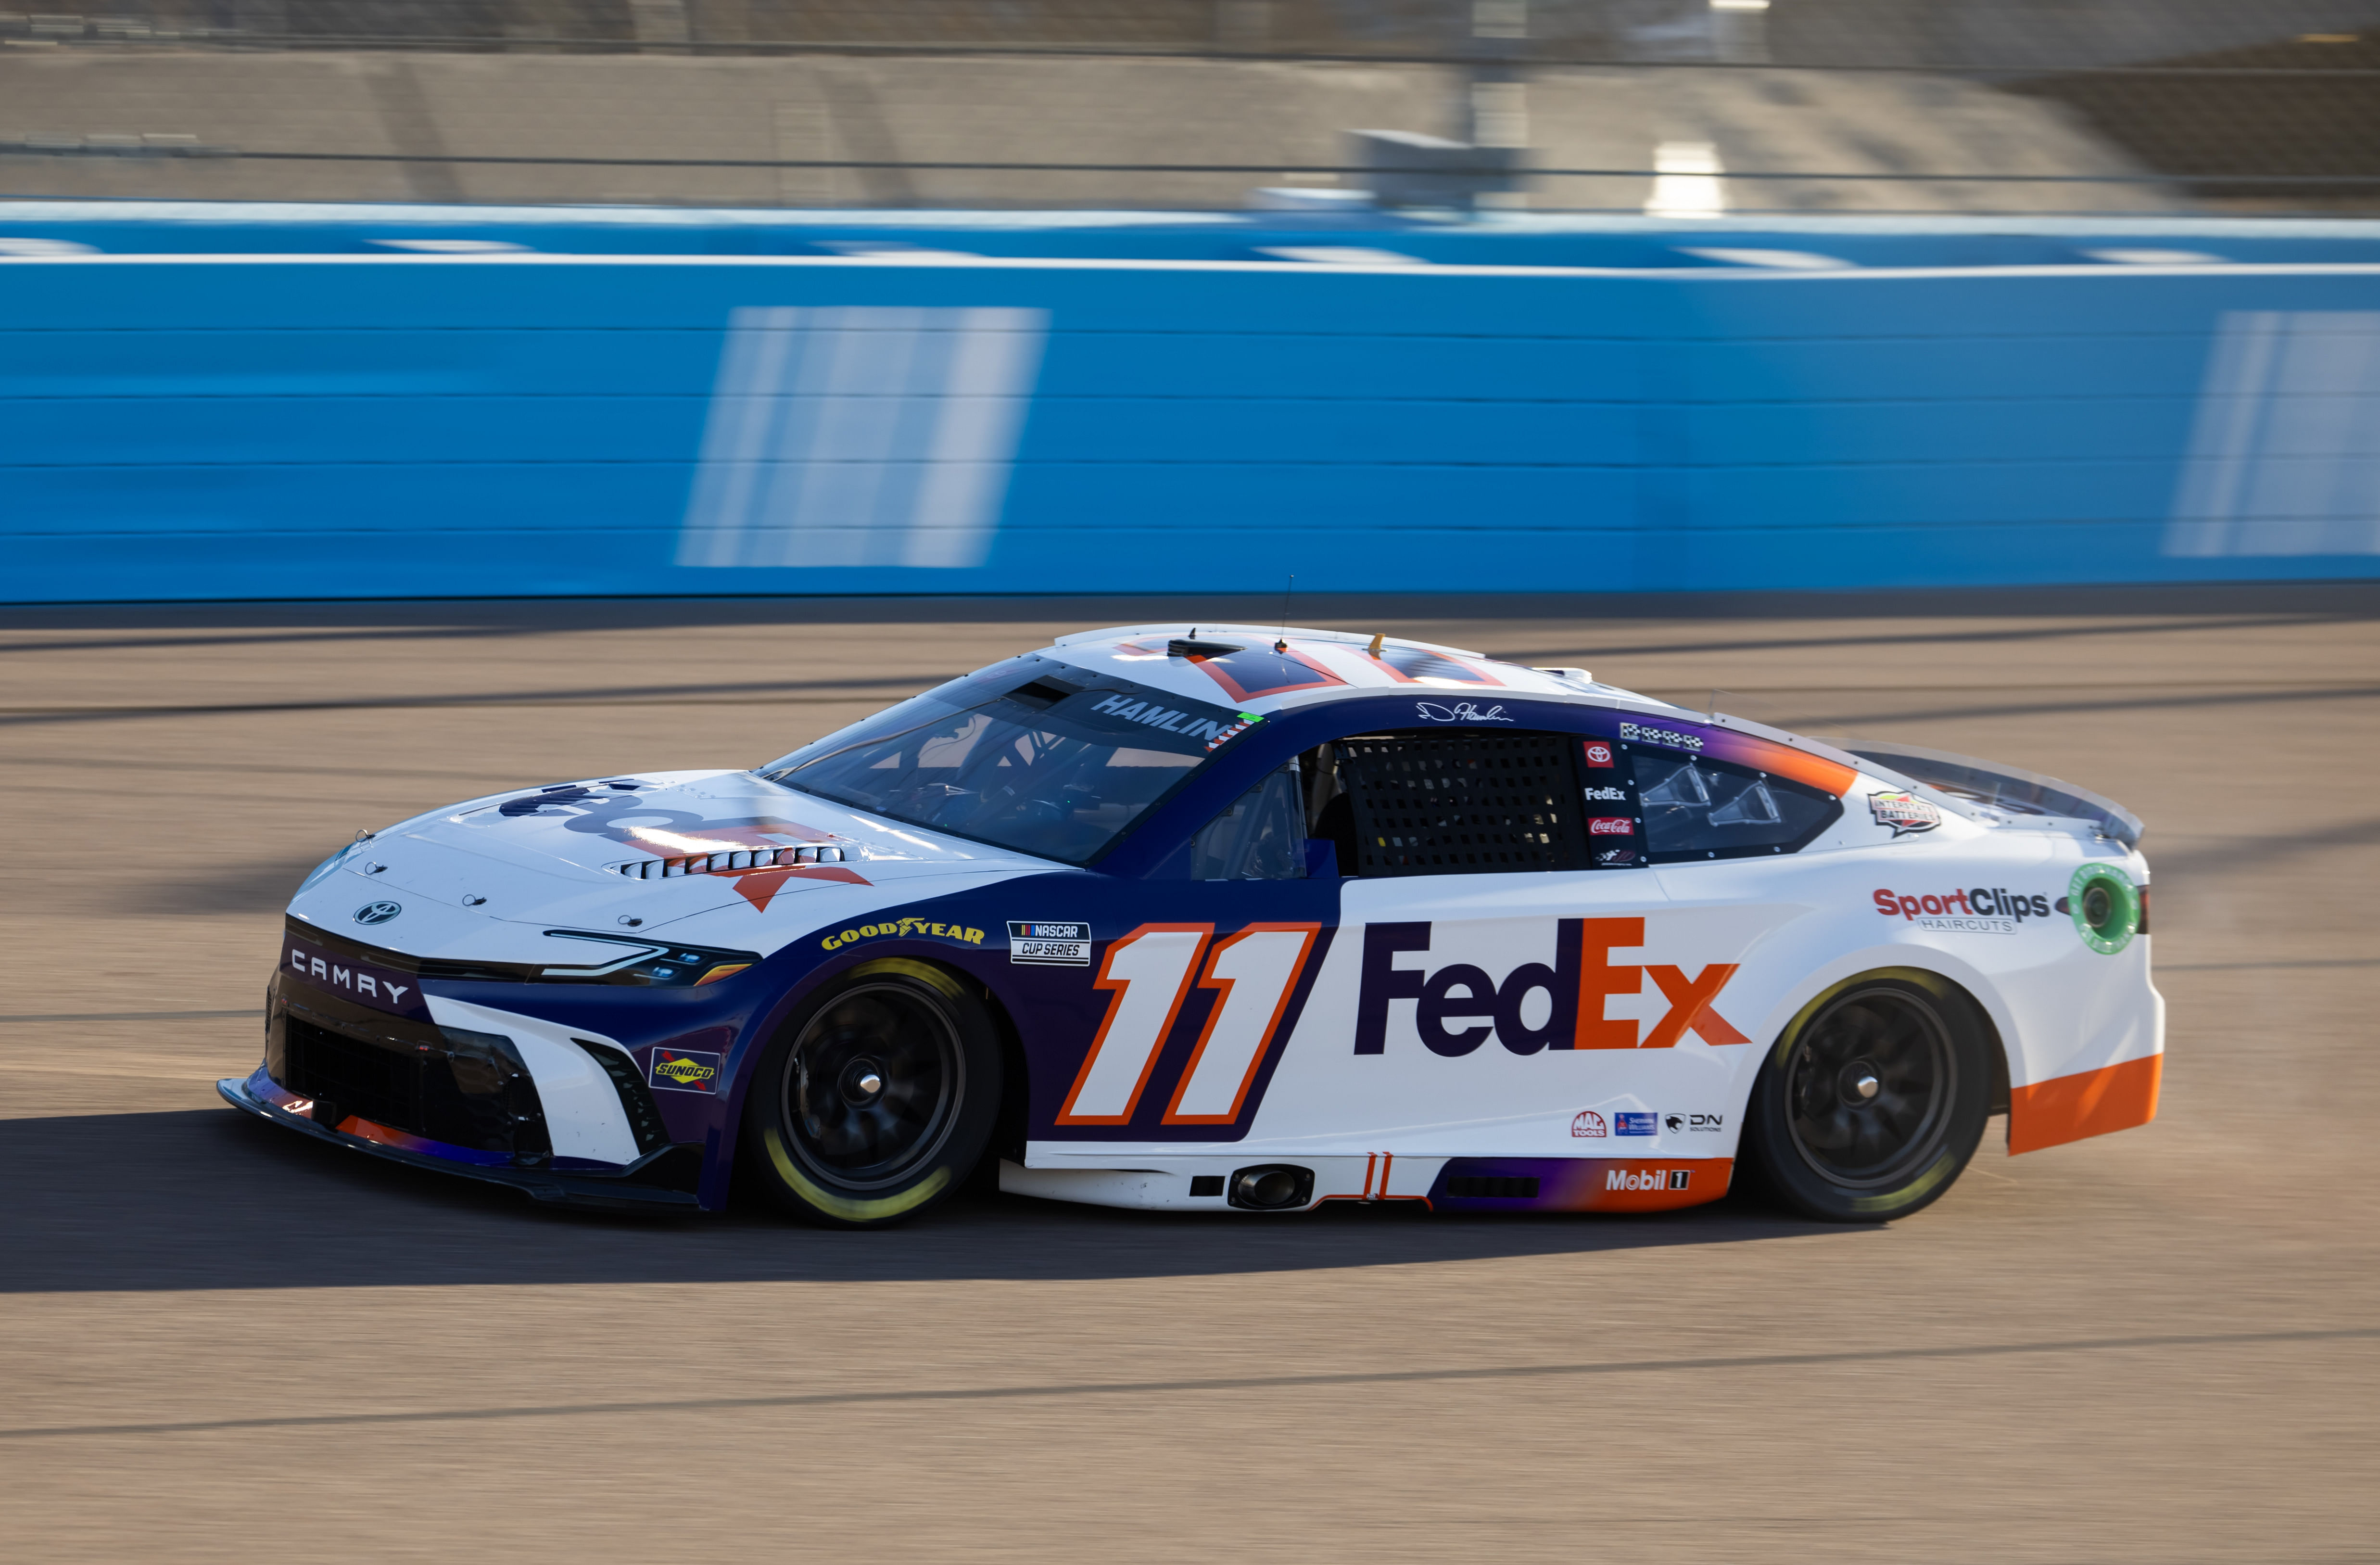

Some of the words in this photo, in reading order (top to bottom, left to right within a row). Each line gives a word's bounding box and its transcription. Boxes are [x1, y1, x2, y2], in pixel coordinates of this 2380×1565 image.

[1090, 694, 1232, 741] HAMLIN
[1584, 787, 1627, 801] FedEx
[821, 917, 985, 951] GOODYEAR
[1035, 925, 1078, 938] NASCAR
[1921, 919, 2013, 932] HAIRCUTS
[1022, 942, 1043, 954] CUP
[1043, 944, 1080, 956] SERIES
[291, 949, 409, 1005] CAMRY
[1354, 916, 1753, 1057] FedEx
[1054, 922, 1322, 1126] 11
[658, 1064, 713, 1078] SUNOCO
[1574, 1112, 1604, 1130] MAC
[1689, 1115, 1723, 1125] DN
[1606, 1170, 1667, 1191] Mobil
